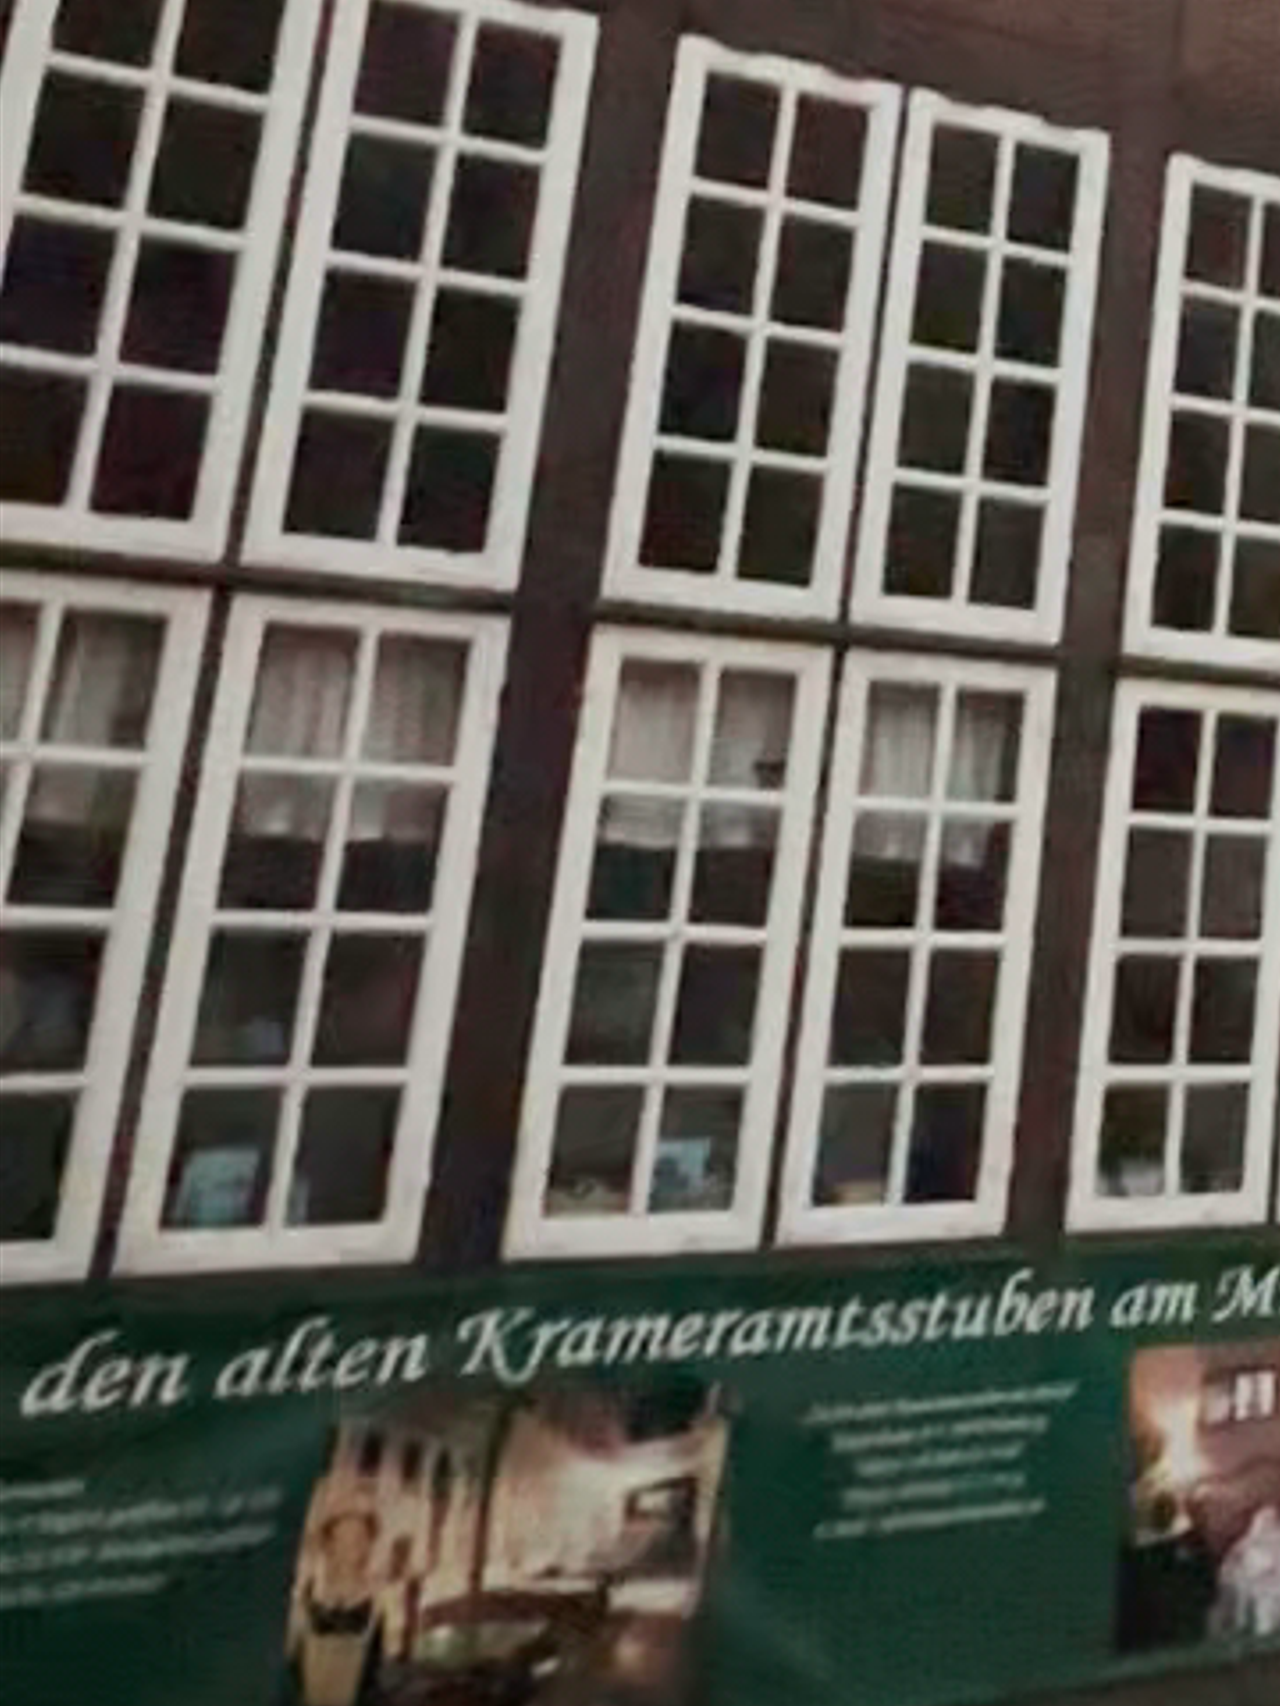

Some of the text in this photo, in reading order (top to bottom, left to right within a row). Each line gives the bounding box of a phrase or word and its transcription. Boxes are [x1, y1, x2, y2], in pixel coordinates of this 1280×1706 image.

[20, 1329, 190, 1418] den
[213, 1317, 429, 1398] alten
[455, 1267, 1095, 1384] Krameramtsstuben
[1109, 1279, 1199, 1327] am
